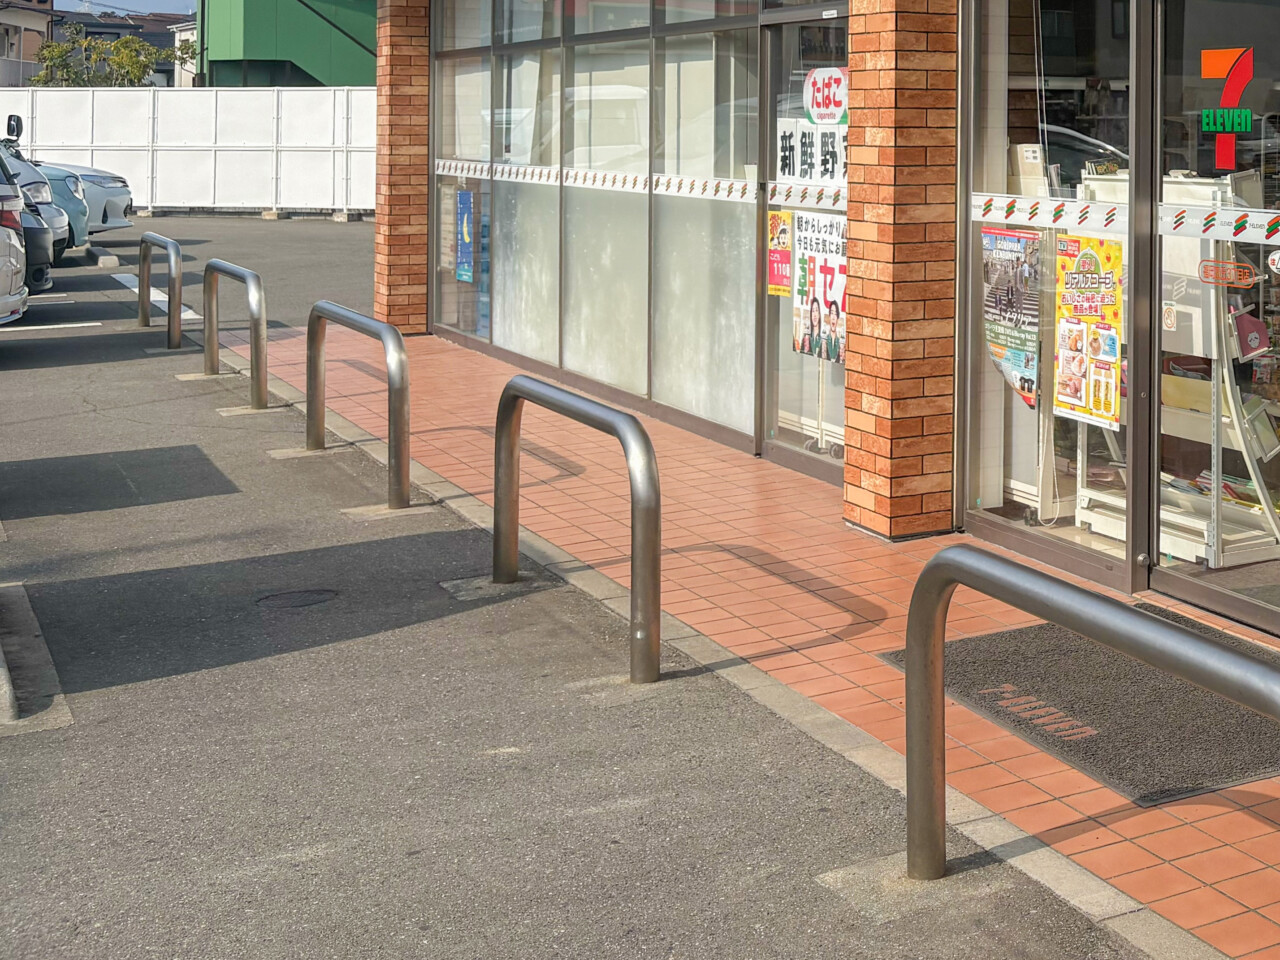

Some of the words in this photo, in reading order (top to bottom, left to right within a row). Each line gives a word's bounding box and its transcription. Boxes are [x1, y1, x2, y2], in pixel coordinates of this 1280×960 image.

[811, 75, 842, 109] たばこ
[1201, 47, 1253, 170] 7
